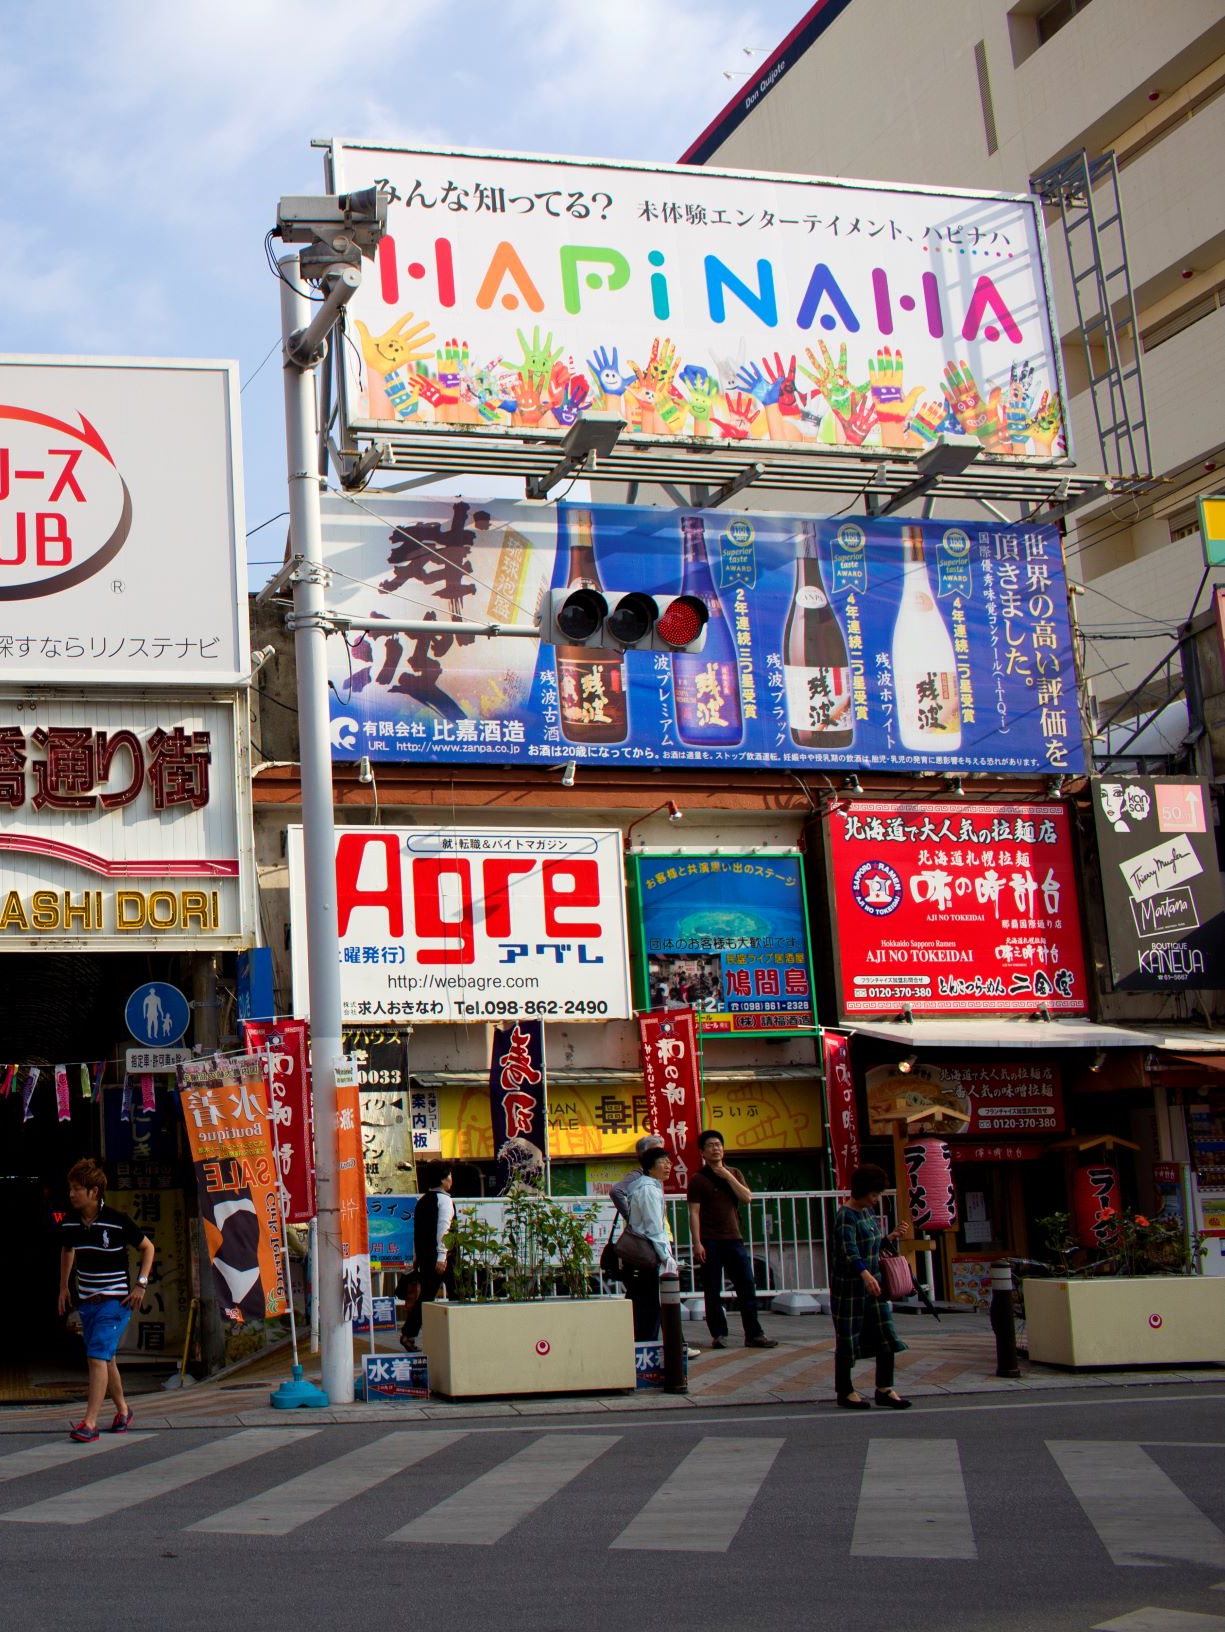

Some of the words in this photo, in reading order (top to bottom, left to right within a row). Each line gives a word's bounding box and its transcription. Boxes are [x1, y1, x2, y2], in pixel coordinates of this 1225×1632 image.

[745, 90, 759, 109] Don
[725, 565, 752, 573] AWARD
[942, 575, 968, 583] AWARD
[1024, 533, 1068, 767] 世界の高い評価を
[540, 670, 560, 742] 残波古酒
[653, 654, 674, 746] 波プレミアム
[766, 653, 786, 747] 残波ブラック
[875, 652, 896, 749] 残波ホワイト
[362, 720, 426, 737] 有限会社
[433, 719, 525, 743] 比嘉酒造
[368, 741, 389, 750] URL
[396, 741, 520, 754] http://www.zanpa.co.jp
[844, 816, 1058, 845] 北海道で大人気の拉麺店
[917, 849, 1031, 867] 北海道札幌拉麺
[877, 863, 901, 891] RAMEN
[335, 833, 603, 964] Agre
[909, 868, 1061, 919] 味の時計台
[116, 889, 220, 930] DORI
[498, 943, 604, 964] アグレ
[866, 950, 887, 962] AJI
[889, 950, 907, 962] NO
[909, 950, 973, 962] TOKEIDAI
[910, 940, 934, 949] Sapporo
[388, 974, 539, 991] http://webagre.com
[726, 968, 809, 998] 鳩間島
[868, 987, 932, 998] 0120-370-380
[357, 1001, 444, 1015] 求人おきなわ
[455, 1001, 608, 1016] Tel.098-862-2490
[412, 1093, 428, 1148] 案内板
[712, 1103, 760, 1119] らいぶ
[993, 1118, 1057, 1129] 0120-370-380
[904, 1146, 933, 1229] ラーメン
[368, 1359, 412, 1383] 水着
